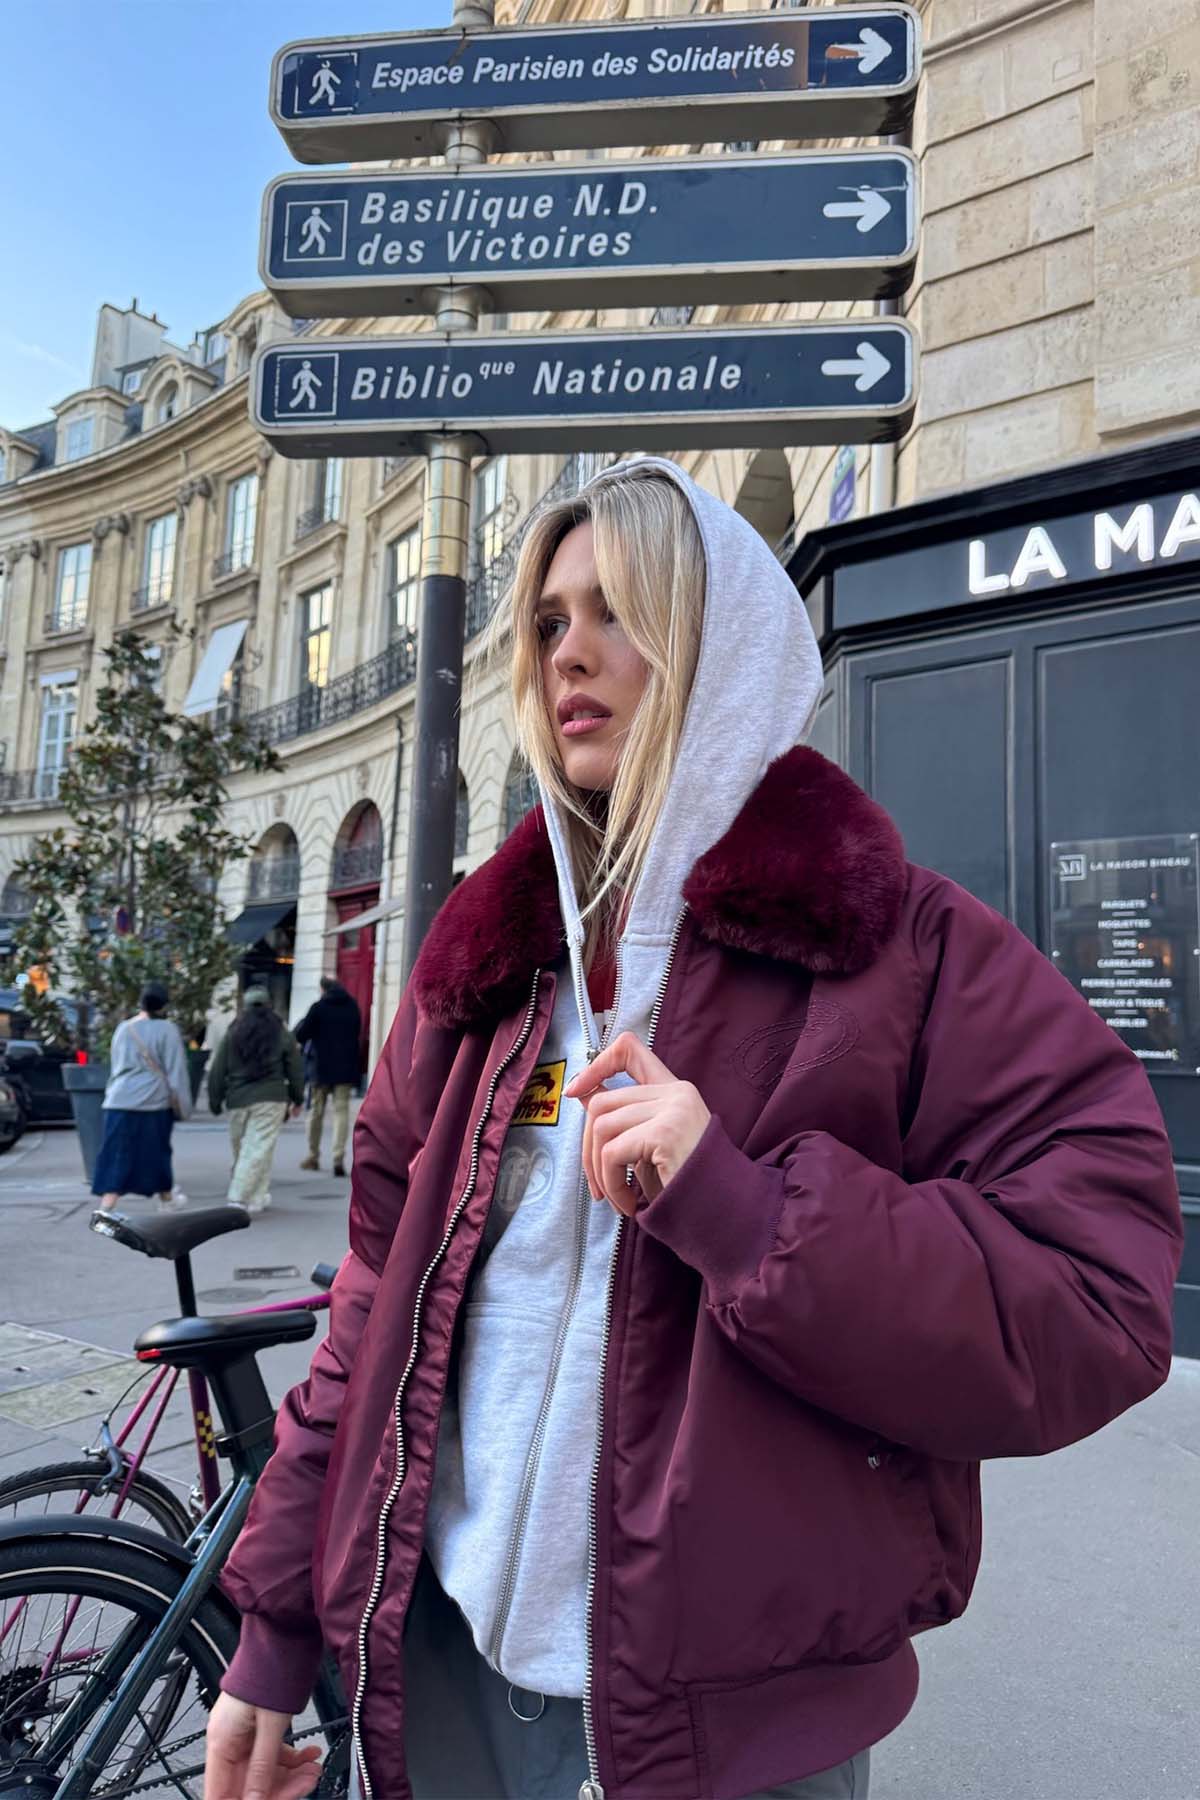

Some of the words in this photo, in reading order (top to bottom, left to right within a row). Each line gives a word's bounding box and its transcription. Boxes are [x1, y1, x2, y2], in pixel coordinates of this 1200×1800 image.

[371, 62, 464, 93] Espace
[473, 54, 584, 83] Parisien
[592, 52, 638, 77] des
[647, 43, 796, 73] Solidarités
[360, 188, 554, 229] Basilique
[573, 182, 657, 217] N.D.
[357, 233, 425, 266] des
[447, 226, 633, 263] Victoires
[532, 356, 742, 395] Nationale
[968, 526, 1067, 595] LA
[1090, 861, 1103, 871] LA
[1106, 859, 1148, 870] MAISON
